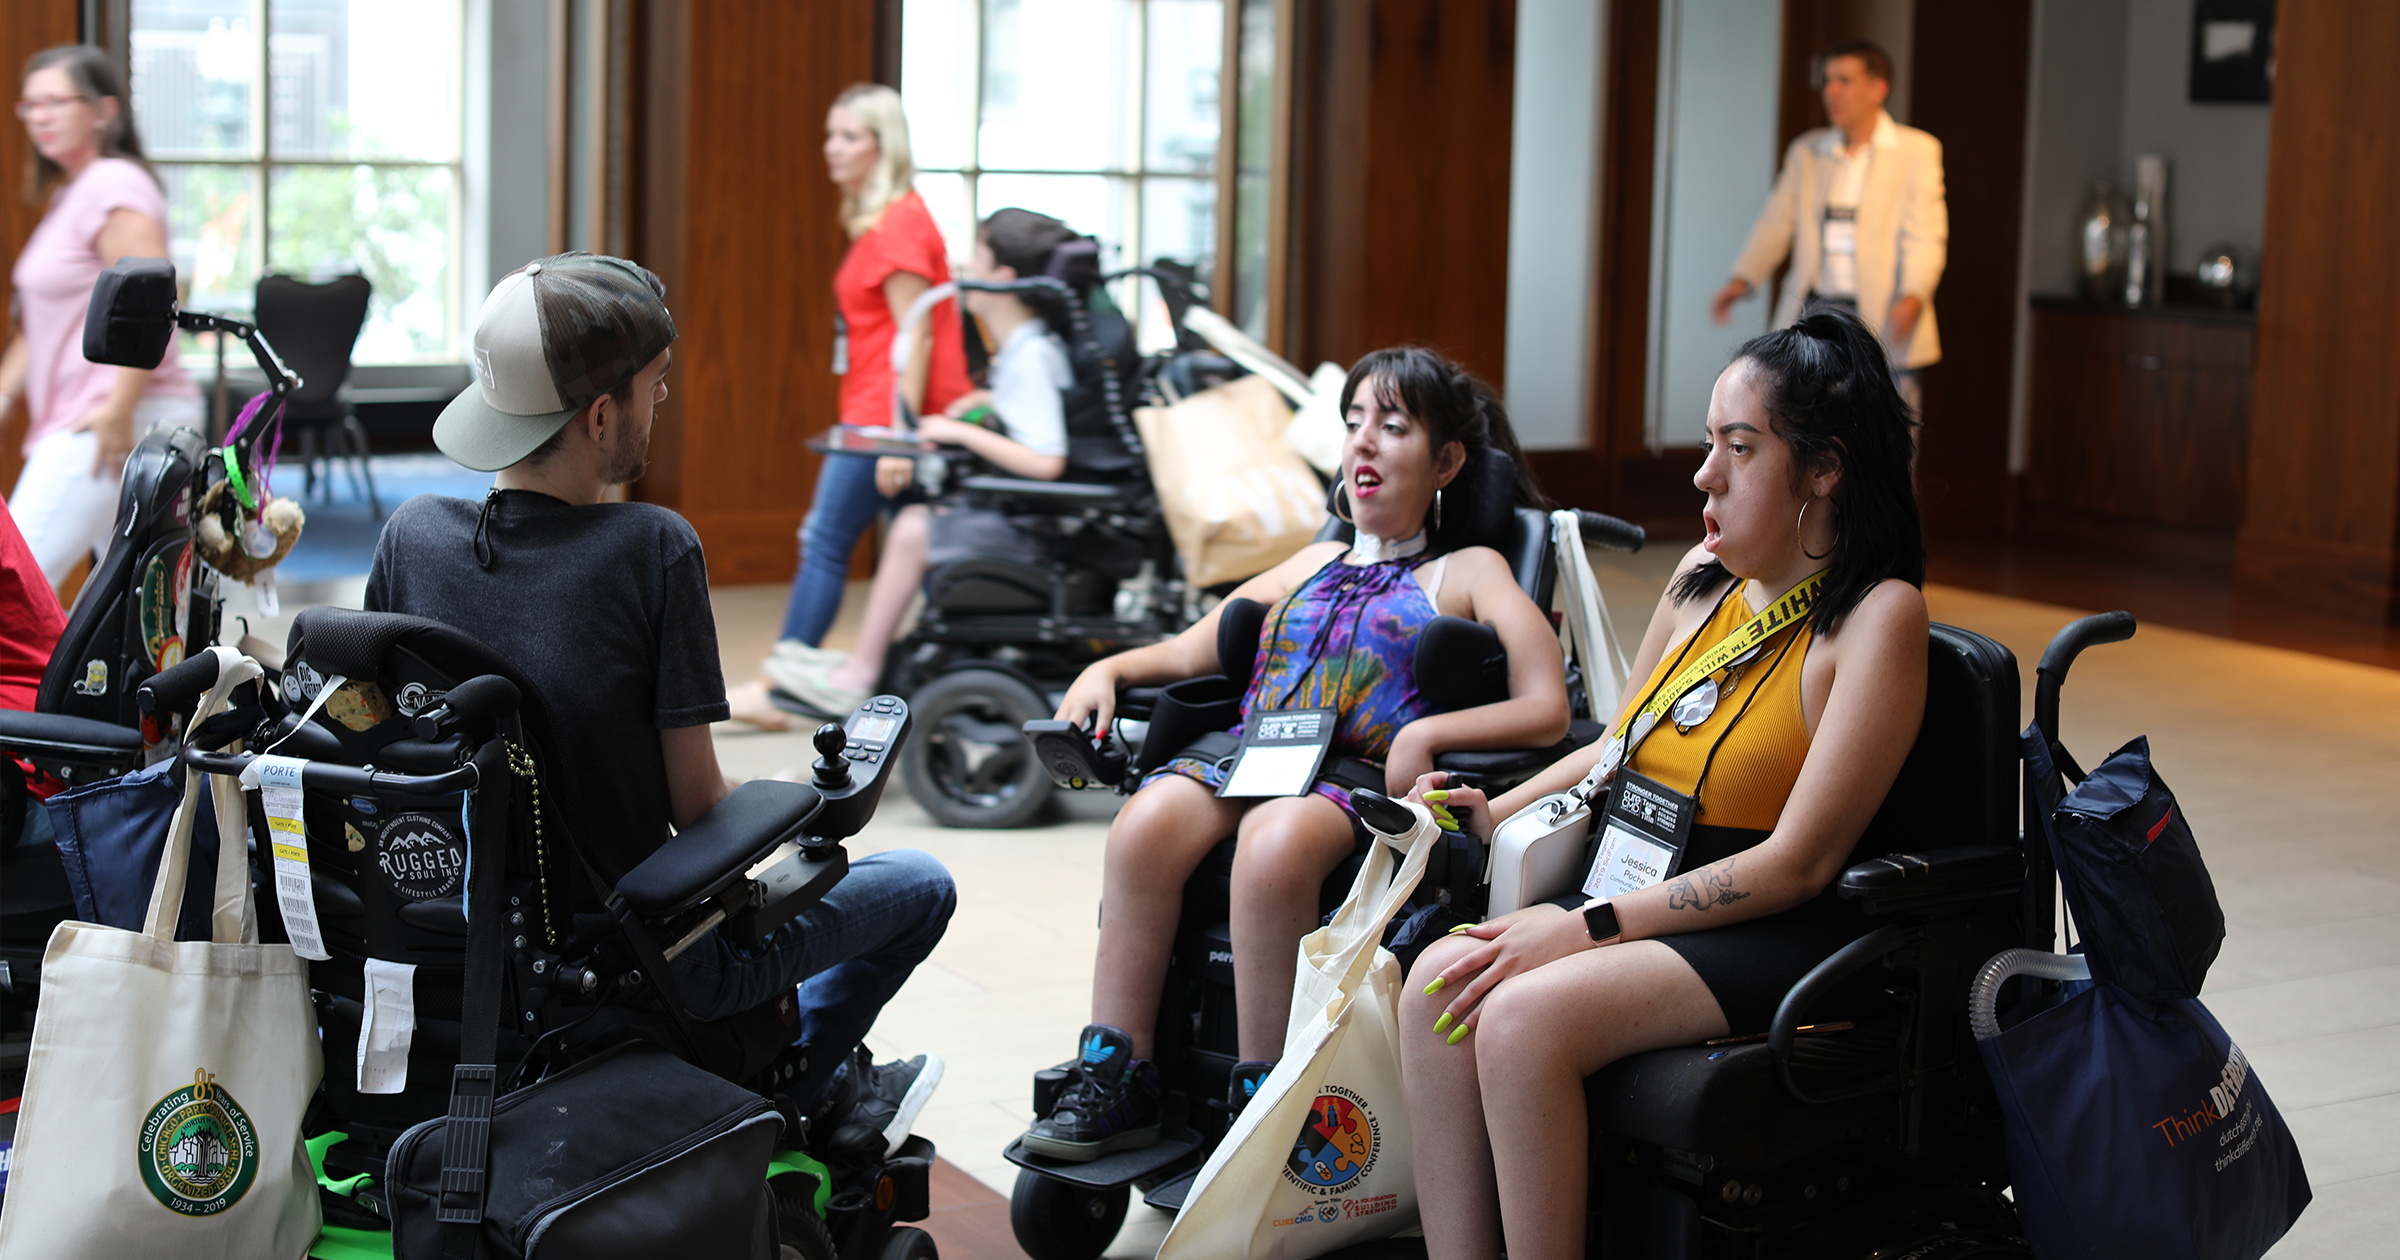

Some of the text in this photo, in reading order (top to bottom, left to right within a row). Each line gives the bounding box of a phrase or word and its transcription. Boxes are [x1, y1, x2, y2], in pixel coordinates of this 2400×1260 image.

[1698, 653, 1729, 674] WILL
[1699, 645, 1727, 666] Weight
[299, 666, 312, 682] BIG
[1646, 693, 1667, 713] Syste
[264, 765, 296, 777] PORTE
[1626, 781, 1652, 797] STRONGER
[1653, 793, 1679, 811] TOGETHER
[381, 816, 406, 840] INDEPENDENT
[406, 815, 431, 825] CLOTHING
[431, 821, 453, 840] COMPANY
[379, 847, 462, 880] RUGGED
[1584, 828, 1612, 892] Stronger Together
[1620, 854, 1658, 877] Jessica
[410, 869, 436, 880] SOUL
[1594, 867, 1606, 889] 2019
[1609, 874, 1635, 891] Community
[1623, 869, 1646, 885] Poche
[401, 886, 437, 898] LIFESTYLE
[438, 877, 456, 894] BRAND
[193, 1067, 215, 1106] 85
[1325, 1085, 1368, 1109] TOGETHER
[141, 1088, 254, 1158] Celebrating Years of Service
[157, 1103, 240, 1161] CHICAGO PARK DISTRICT SEAL
[1282, 1116, 1381, 1196] IENTIFIC & FAMILY CONFERENCE
[161, 1165, 236, 1198] ORGANIZED 1934
[170, 1197, 193, 1213] 1934
[204, 1197, 226, 1213] 2019
[1354, 1199, 1397, 1212] BUILDING
[1360, 1193, 1397, 1204] FOUNDATION
[1355, 1204, 1397, 1217] STRENGTH
